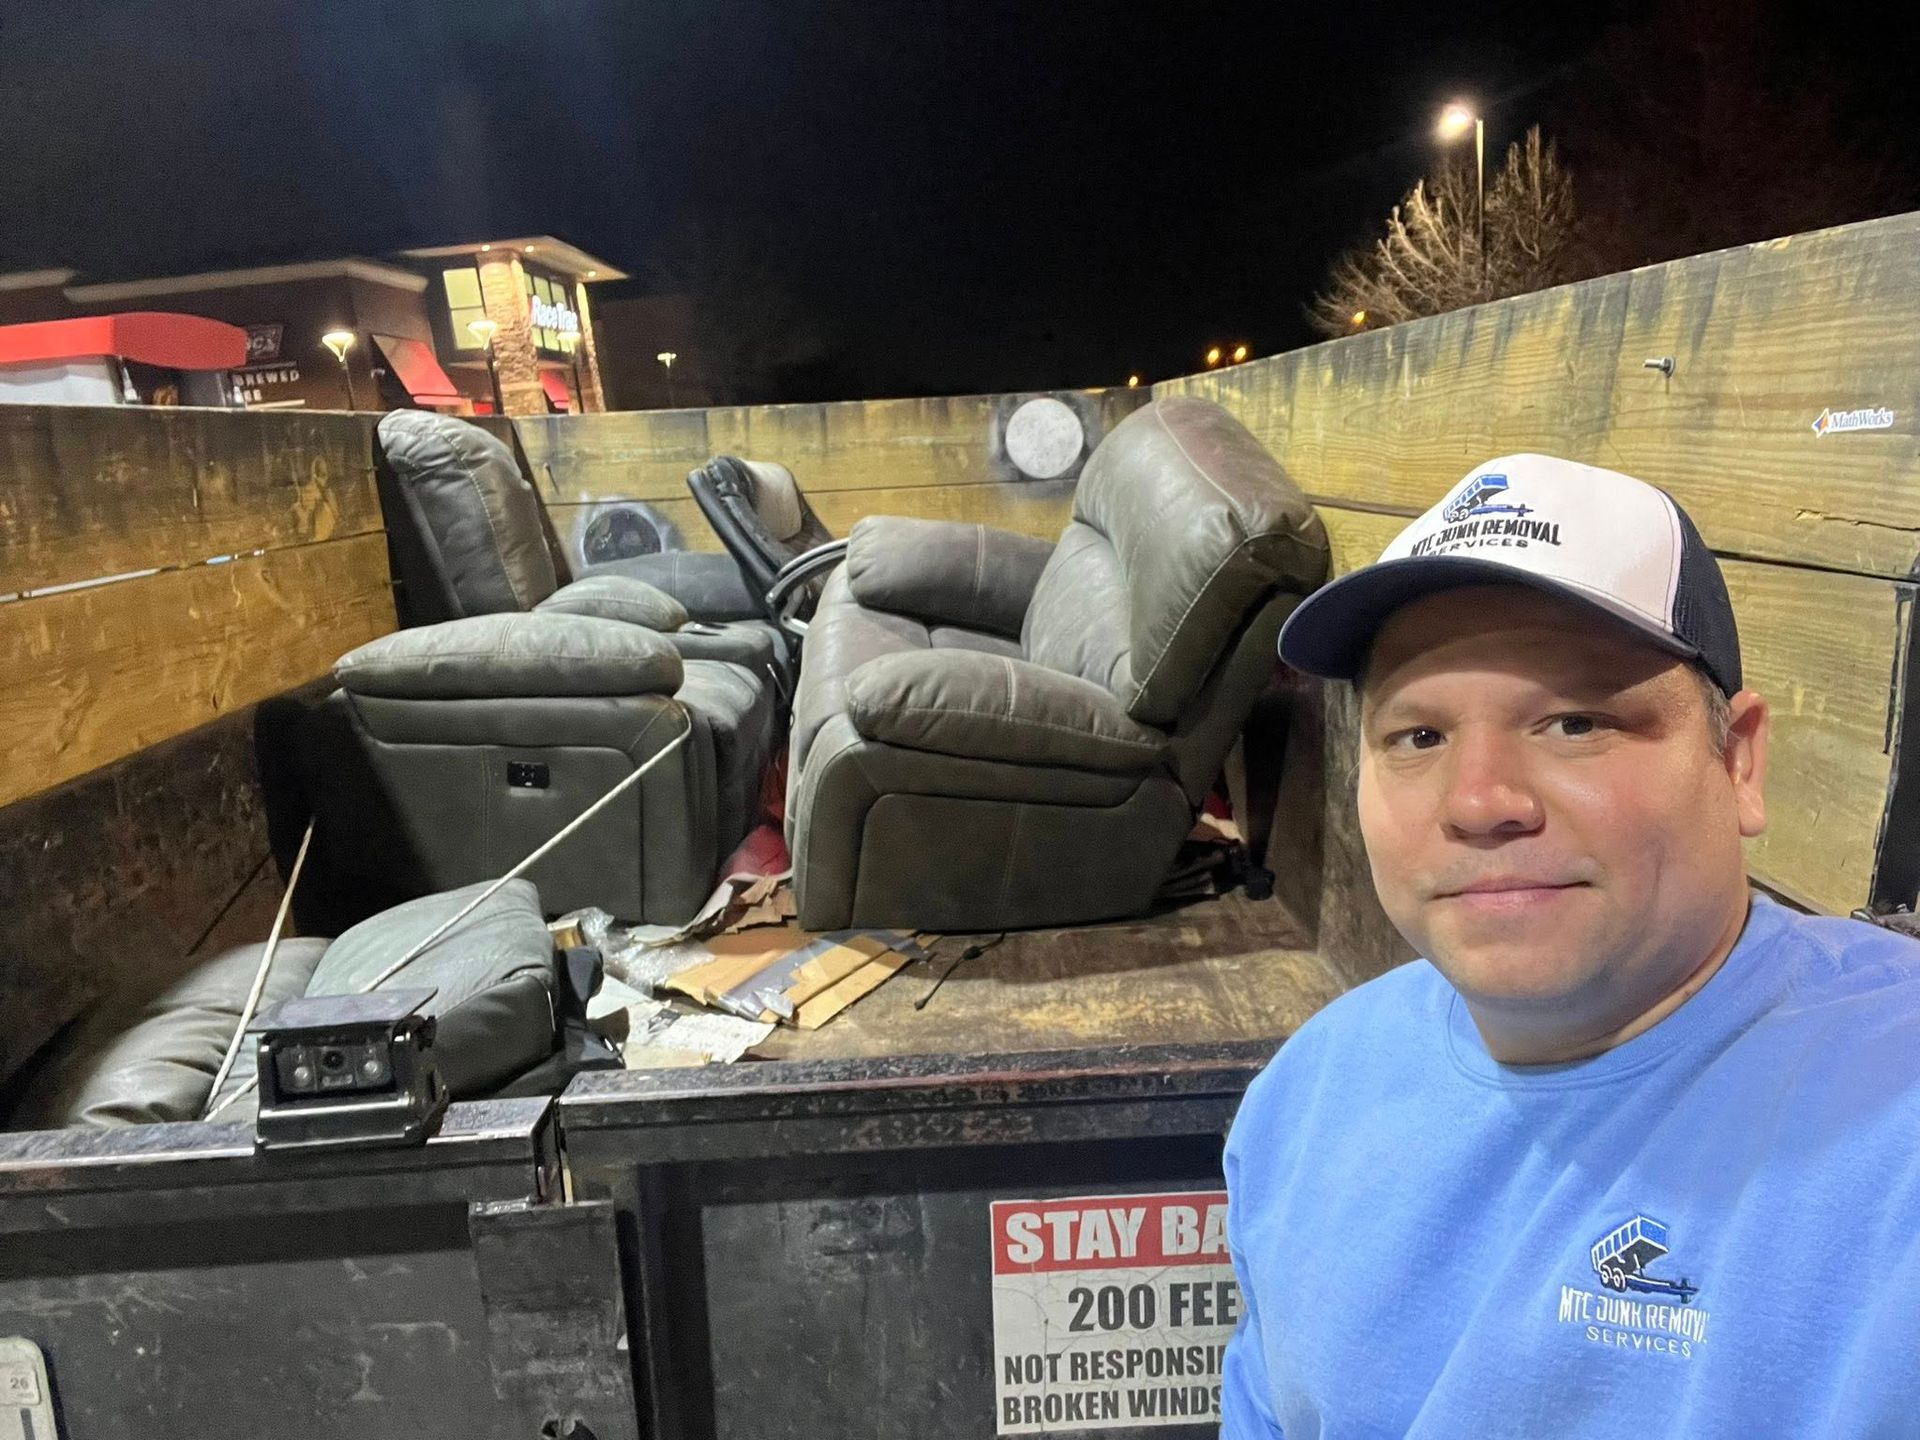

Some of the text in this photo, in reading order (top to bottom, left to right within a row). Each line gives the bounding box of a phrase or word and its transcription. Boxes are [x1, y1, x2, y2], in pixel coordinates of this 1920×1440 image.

[1831, 410, 1892, 429] MathWorks
[1436, 521, 1480, 547] JUNK
[1481, 519, 1562, 547] REMOVAL
[1005, 1203, 1231, 1265] STAY BA
[1068, 1281, 1240, 1332] 200 FEE
[1558, 1285, 1710, 1344] MTC JUNK REMOV
[1586, 1325, 1692, 1357] SERVICES
[10, 1376, 29, 1390] 26
[1004, 1344, 1223, 1385] NOT RESPONSI
[1002, 1385, 1222, 1426] BROKEN WINDS
